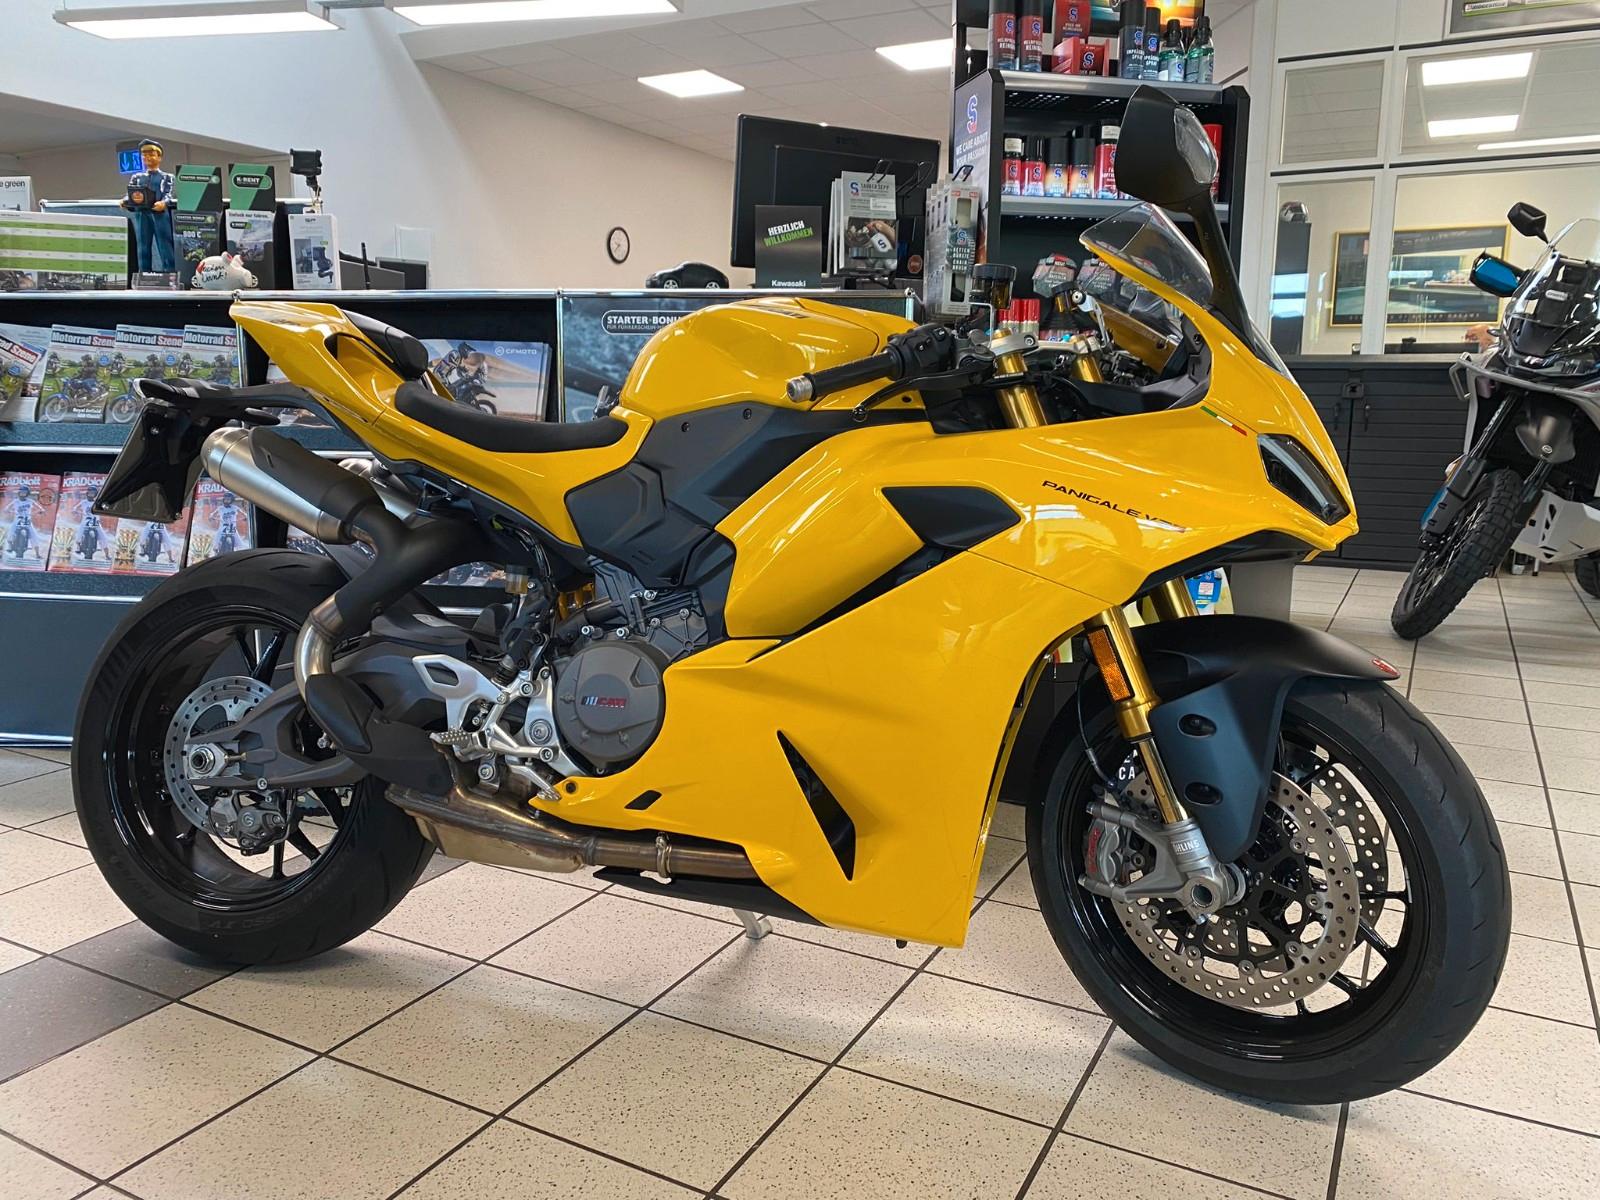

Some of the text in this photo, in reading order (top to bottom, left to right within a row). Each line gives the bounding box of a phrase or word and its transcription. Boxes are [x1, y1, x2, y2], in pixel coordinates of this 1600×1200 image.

[5, 180, 25, 188] green
[768, 220, 805, 236] HERZLICH
[764, 227, 814, 247] WILLKOMMEN
[52, 332, 91, 345] Motorrad
[117, 331, 182, 347] Motorrad Szene
[184, 332, 223, 345] Motorrad
[10, 346, 37, 364] Szene
[1042, 480, 1141, 518] PANIGALE
